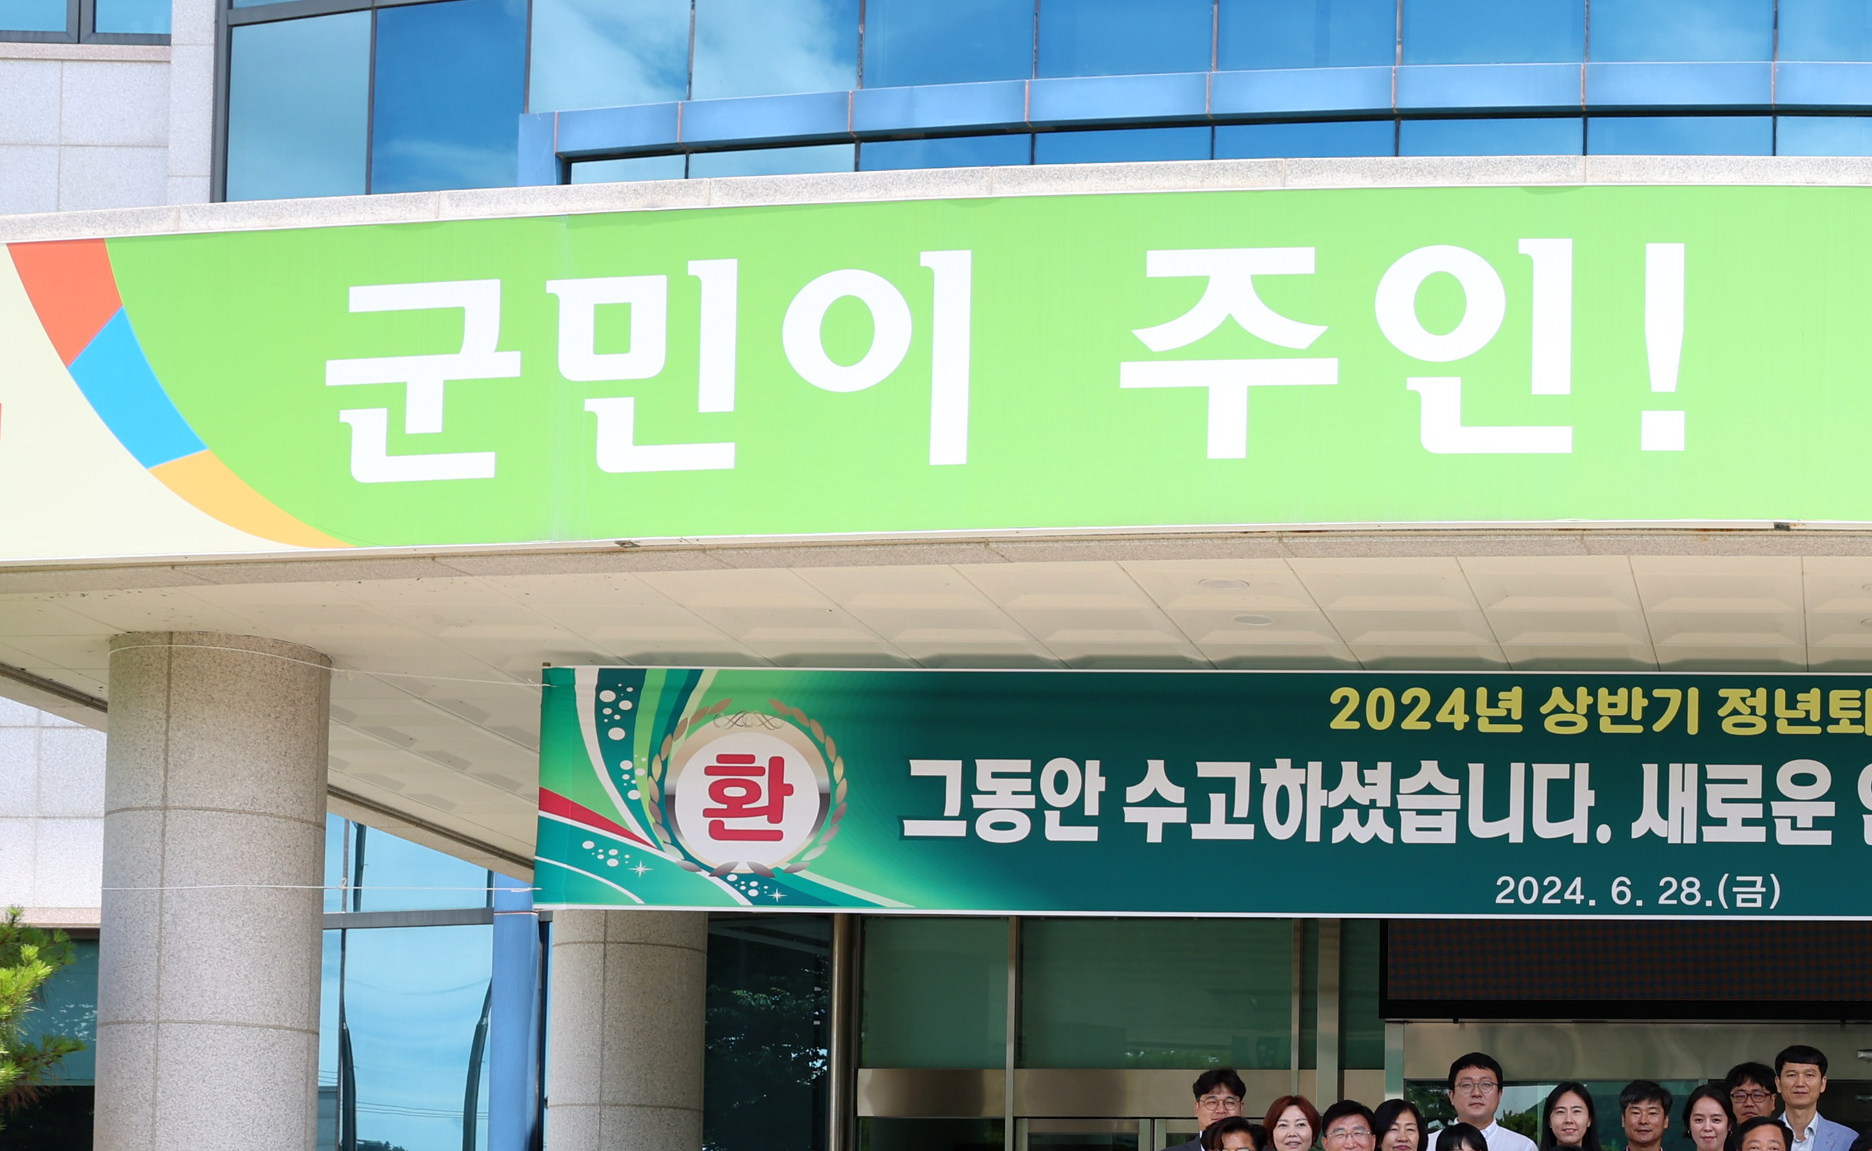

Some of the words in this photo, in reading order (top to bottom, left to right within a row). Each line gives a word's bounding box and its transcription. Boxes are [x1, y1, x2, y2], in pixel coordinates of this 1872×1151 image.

[326, 250, 971, 482] 군민이
[1120, 239, 1685, 458] 주인!
[1331, 687, 1522, 733] 2024년
[1541, 687, 1698, 734] 상반기
[703, 753, 793, 842] 환
[903, 758, 1105, 843] 그동안
[1123, 759, 1611, 844] 수고하셨습니다.
[1632, 760, 1835, 845] 새로운
[1496, 876, 1596, 906] 2024.
[1612, 877, 1642, 906] 6.
[1659, 874, 1781, 909] 28.(금)
